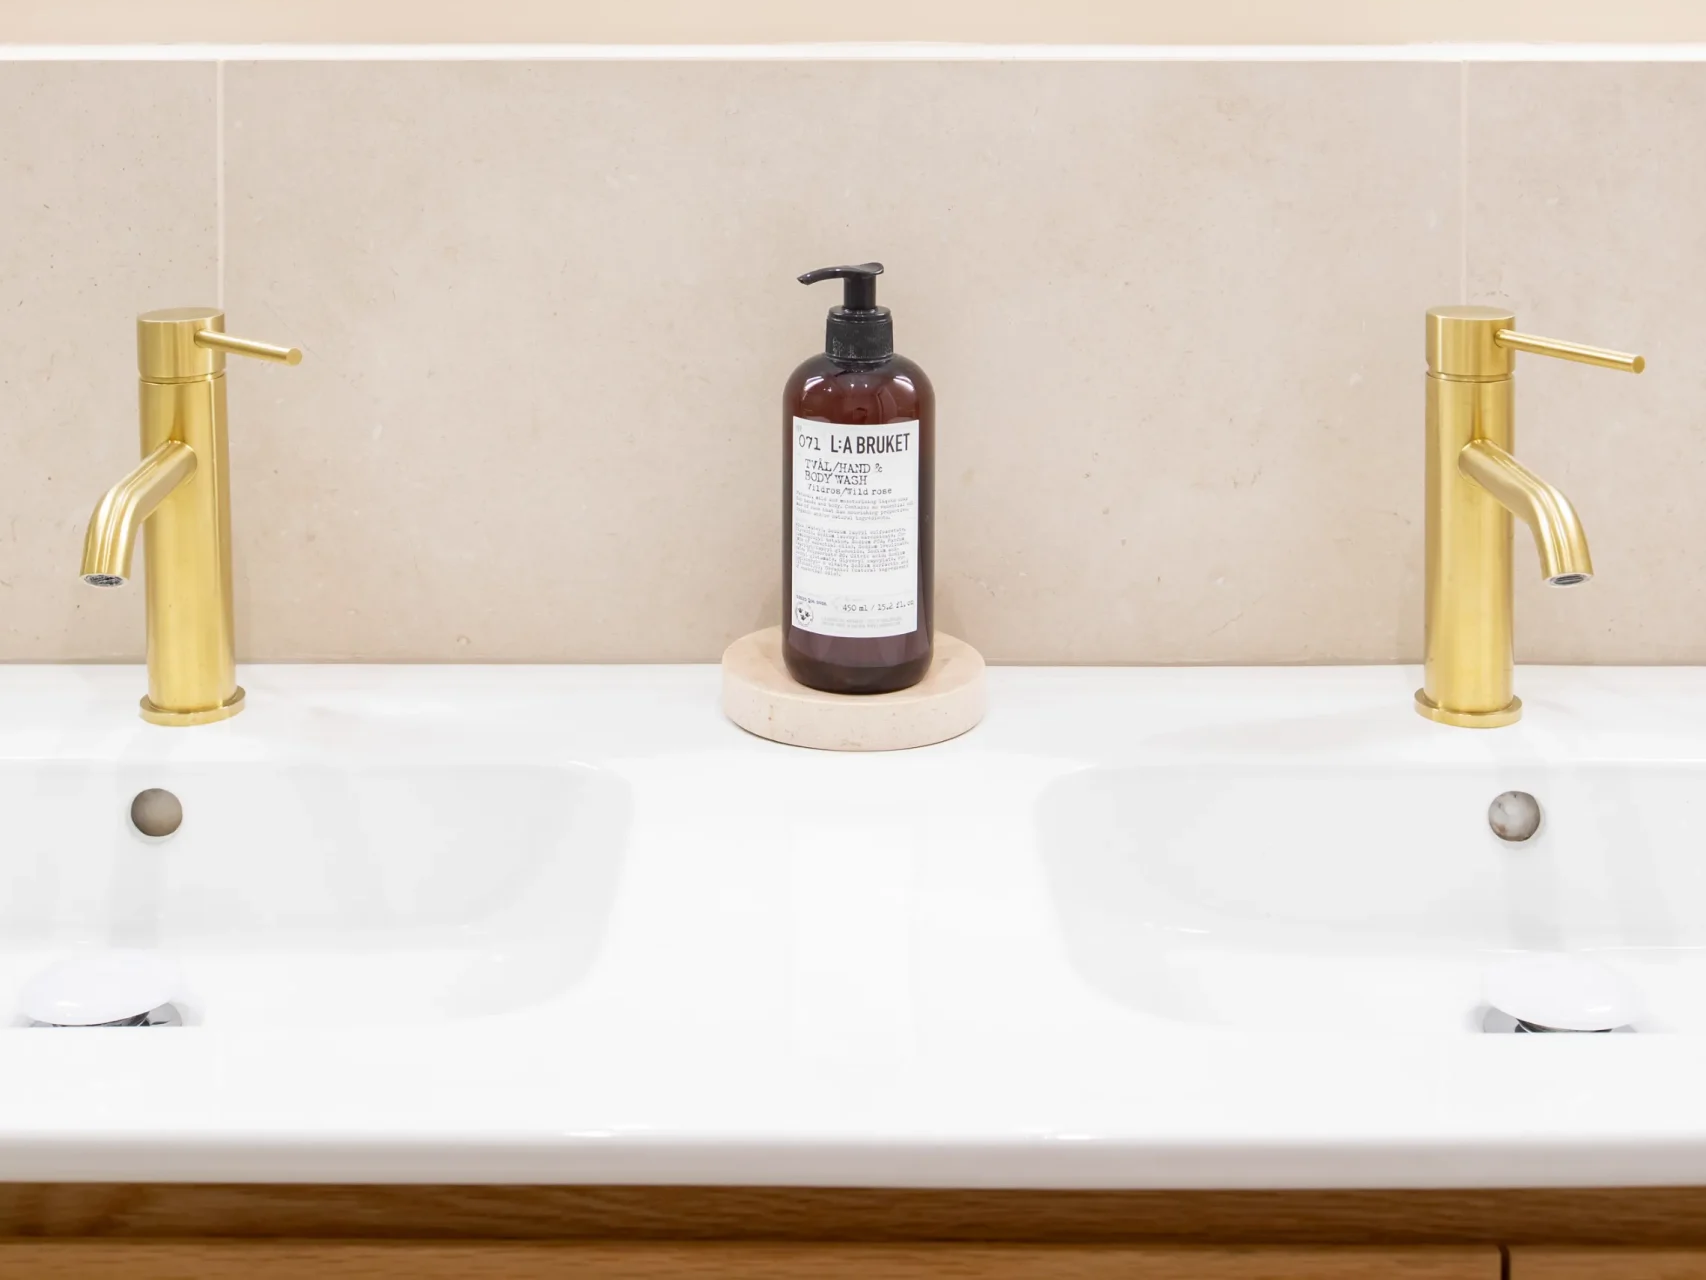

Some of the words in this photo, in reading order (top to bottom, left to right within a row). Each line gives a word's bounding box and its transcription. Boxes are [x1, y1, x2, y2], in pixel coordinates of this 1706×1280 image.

[798, 434, 821, 451] 071
[830, 434, 853, 454] L:A
[856, 433, 911, 455] BRUKET
[804, 458, 871, 474] TVÅL/HAND
[804, 470, 833, 484] BODY
[834, 475, 868, 486] WASH
[872, 487, 892, 496] rose
[842, 604, 857, 612] 450
[858, 604, 868, 612] ml
[877, 602, 893, 611] 15.2
